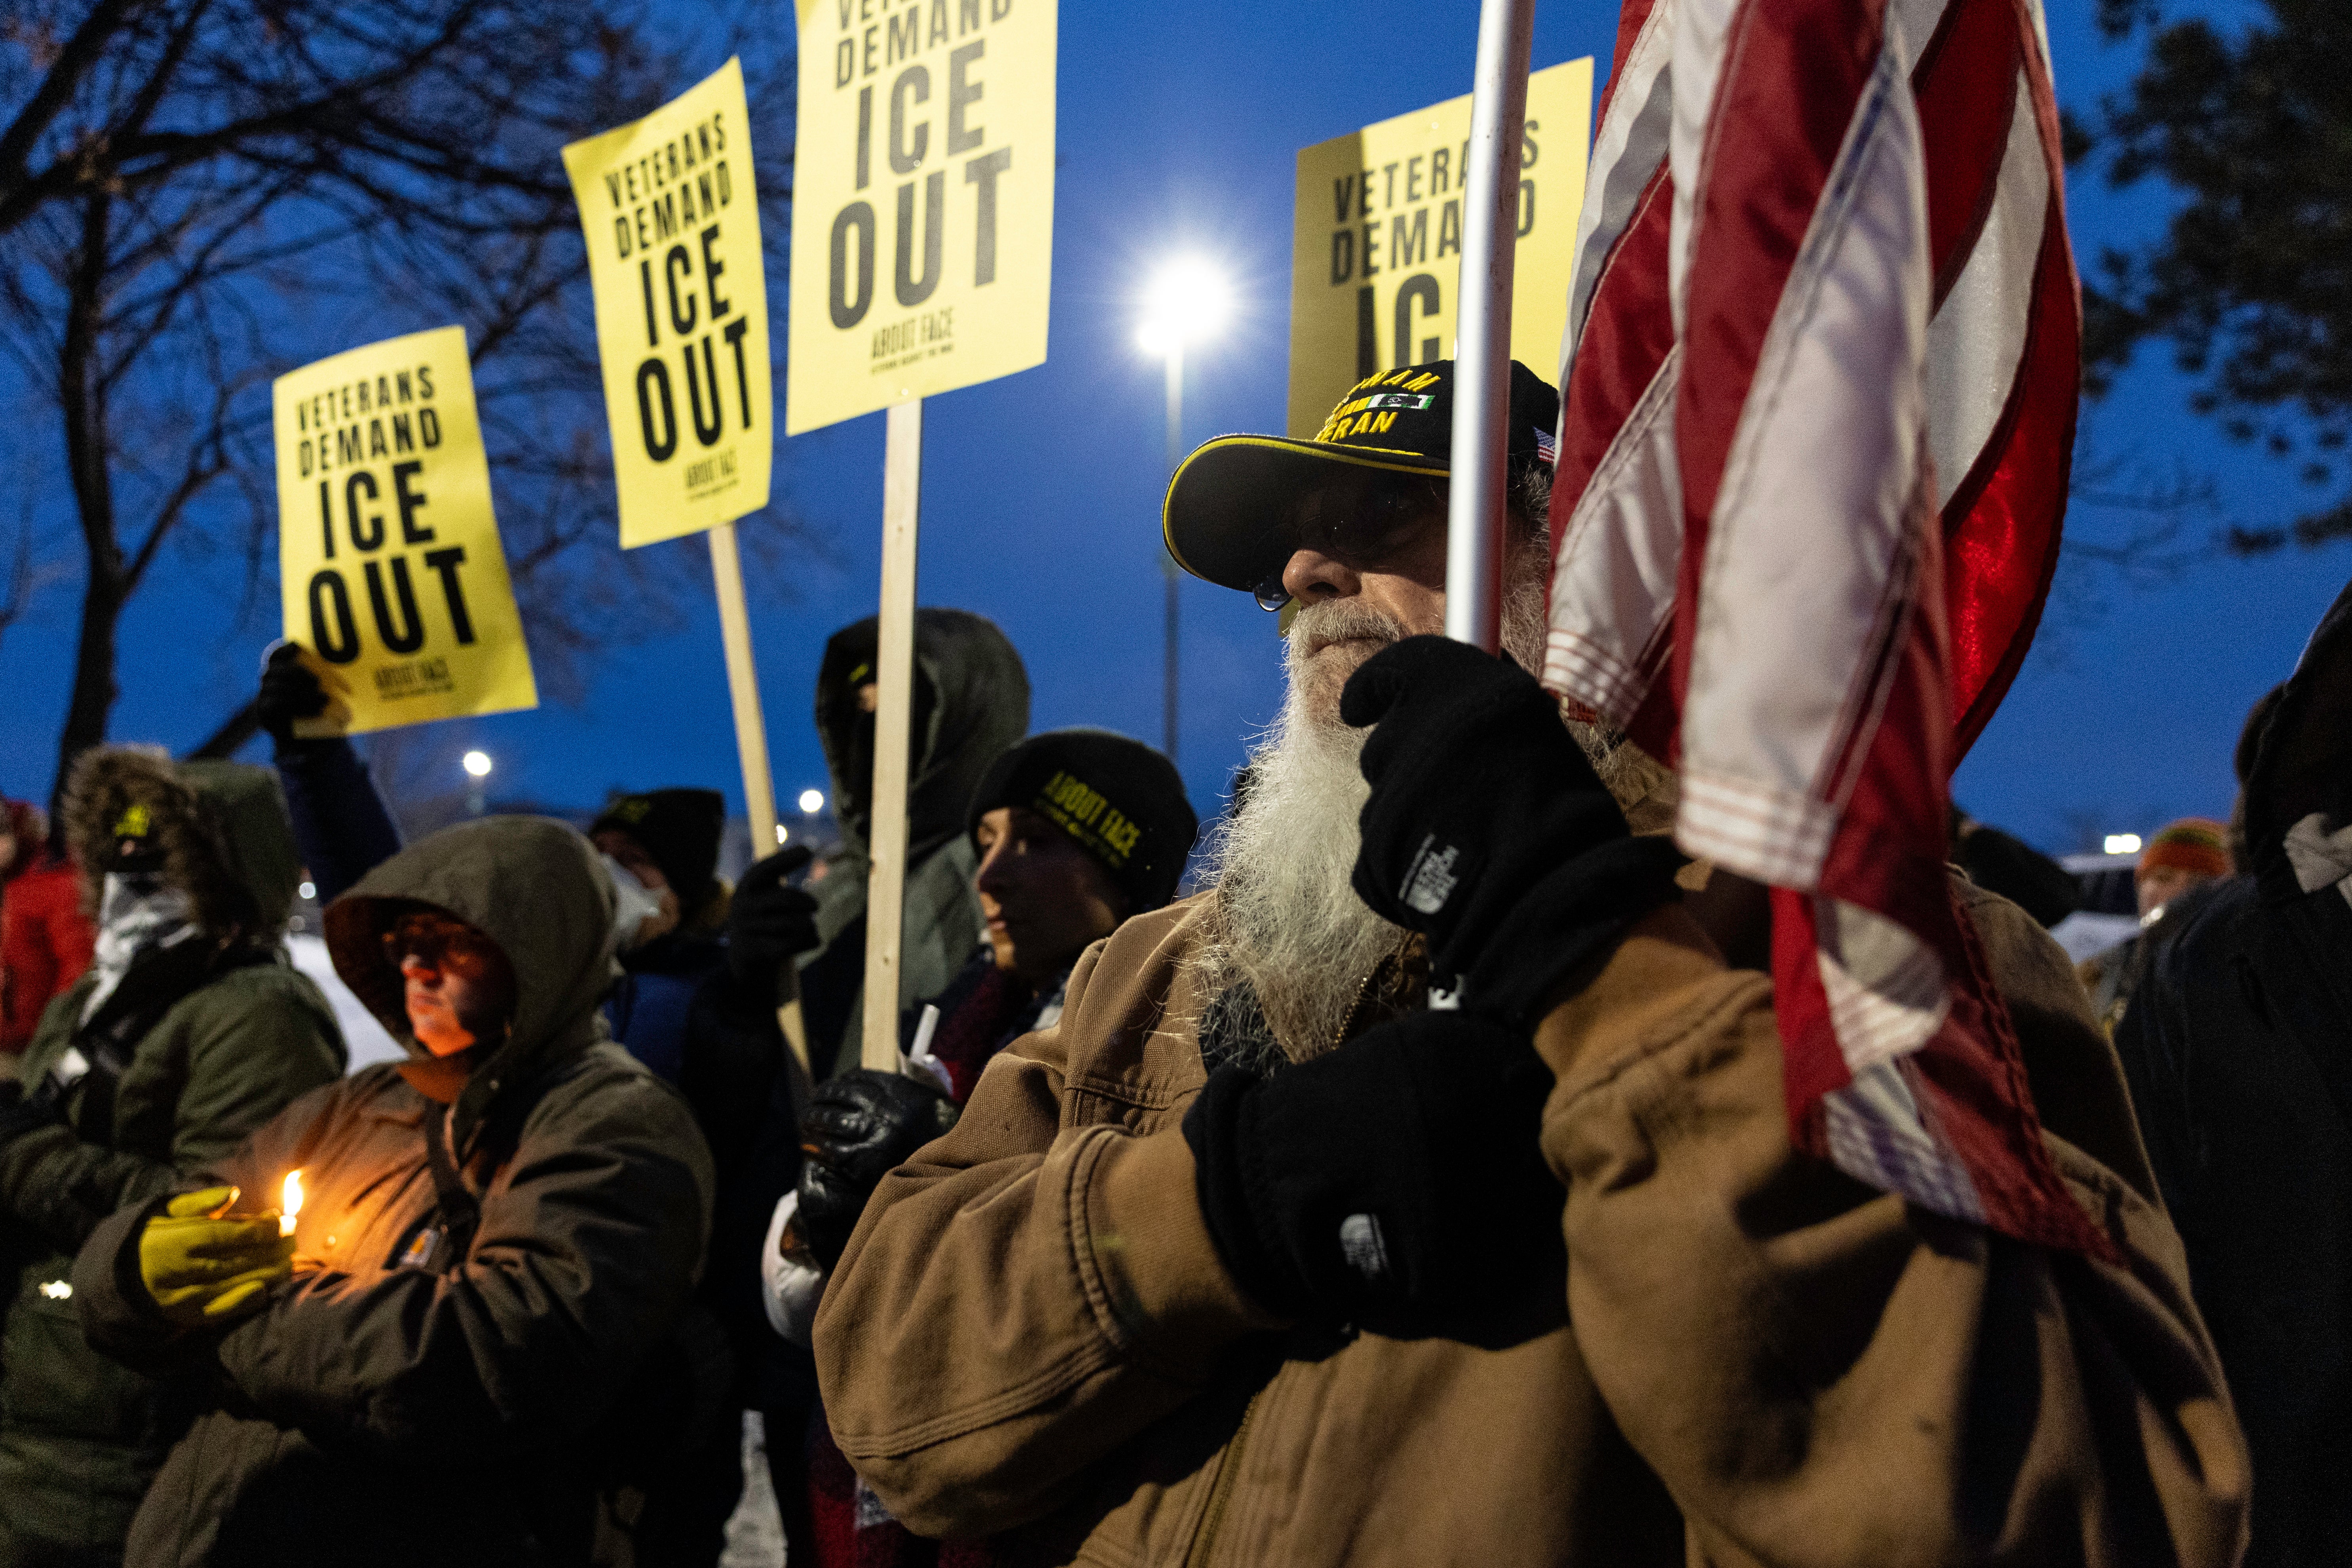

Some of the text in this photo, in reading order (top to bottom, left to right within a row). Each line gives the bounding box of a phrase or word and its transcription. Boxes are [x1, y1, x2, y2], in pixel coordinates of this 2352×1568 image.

[605, 111, 726, 207] VETERANS
[856, 38, 985, 191] ICE
[615, 160, 731, 259] DEMAND
[1333, 120, 1539, 223] VETERS
[828, 145, 1012, 330] OUT
[1331, 179, 1535, 287] DEMAD
[640, 224, 730, 349] ICE
[1358, 273, 1440, 379] IC
[872, 318, 915, 359] ABOUT
[298, 366, 435, 431] VETERANS
[635, 316, 750, 463] OUT
[1314, 412, 1398, 441] ERAN
[299, 408, 441, 478] DEMAND
[320, 460, 434, 559] ICE
[308, 547, 477, 665] OUT
[1042, 770, 1107, 825] ABOUT
[1099, 808, 1140, 858] FACE
